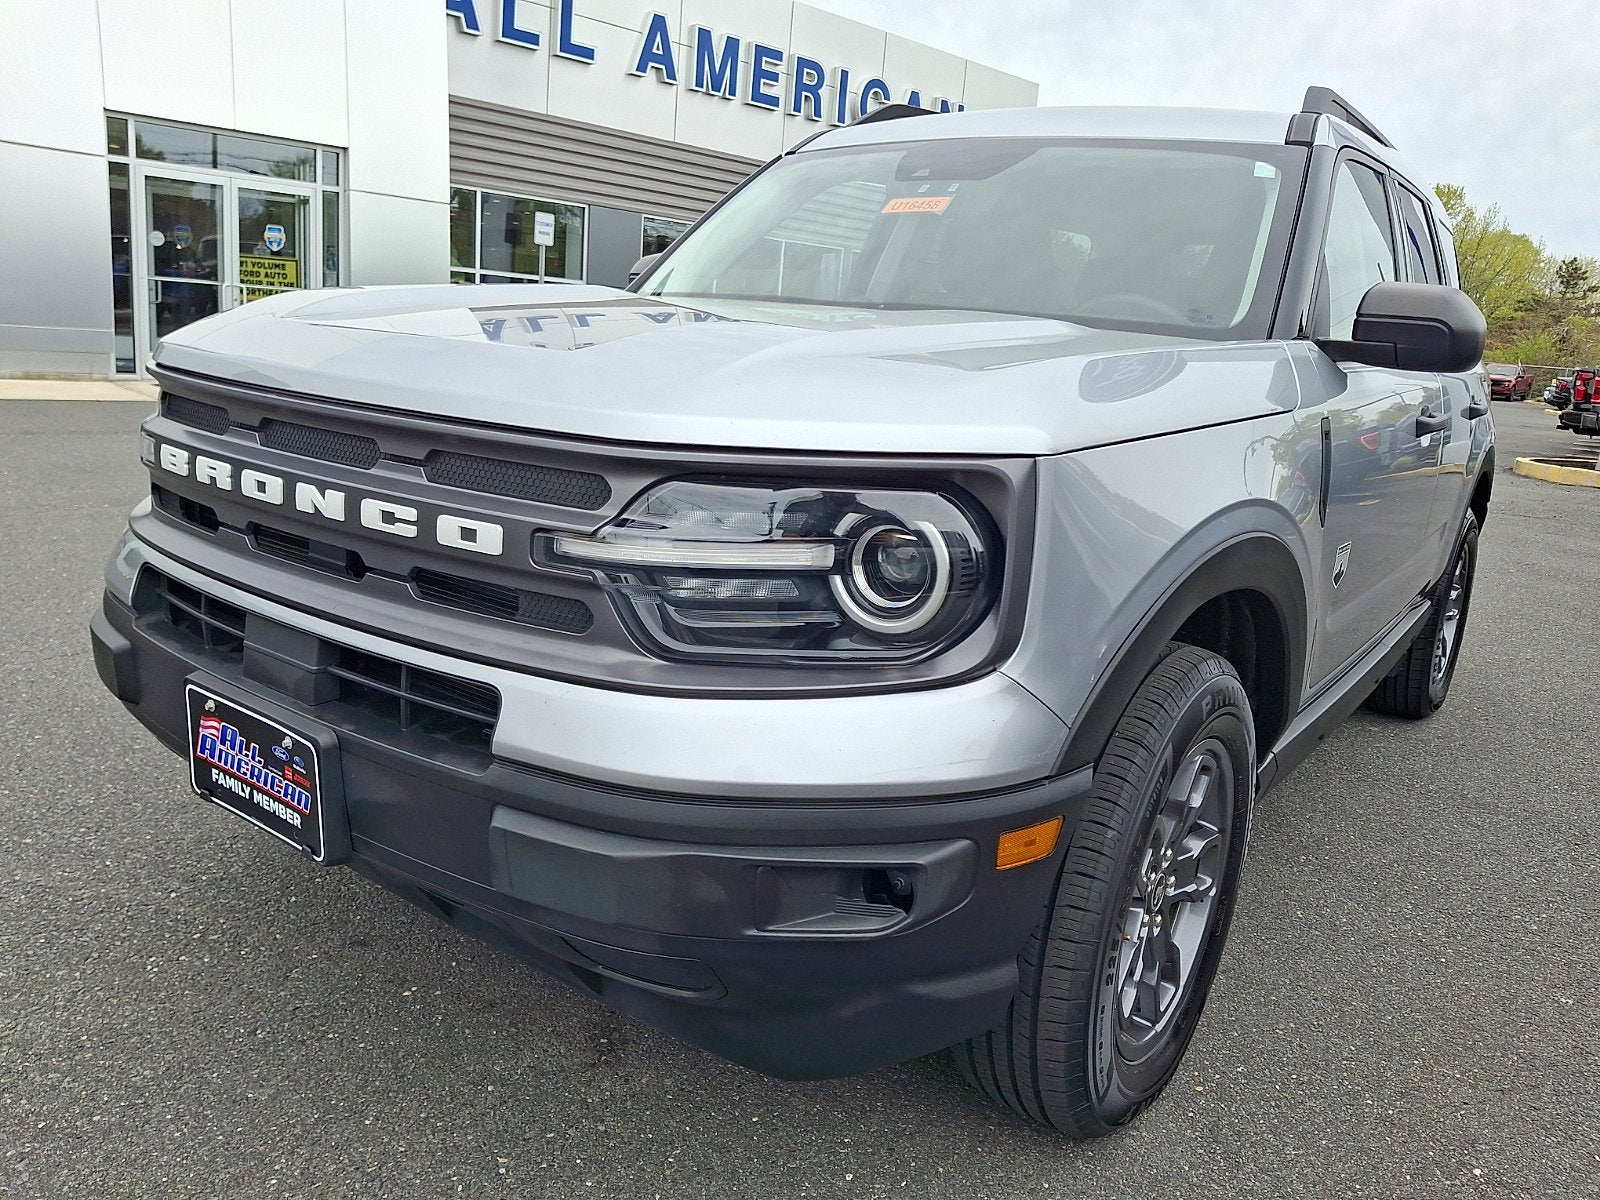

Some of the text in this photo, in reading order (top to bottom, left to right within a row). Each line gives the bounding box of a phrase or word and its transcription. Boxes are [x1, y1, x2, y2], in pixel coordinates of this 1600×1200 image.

[628, 10, 966, 128] AMERIC
[891, 200, 942, 211] U16458
[251, 261, 287, 271] VOLUME
[264, 271, 288, 280] AUTO
[160, 443, 504, 556] BRONCO
[219, 722, 264, 766] ALL
[198, 733, 312, 814] AMERICAN
[211, 767, 251, 800] FAMILY
[253, 789, 302, 829] MEMBER
